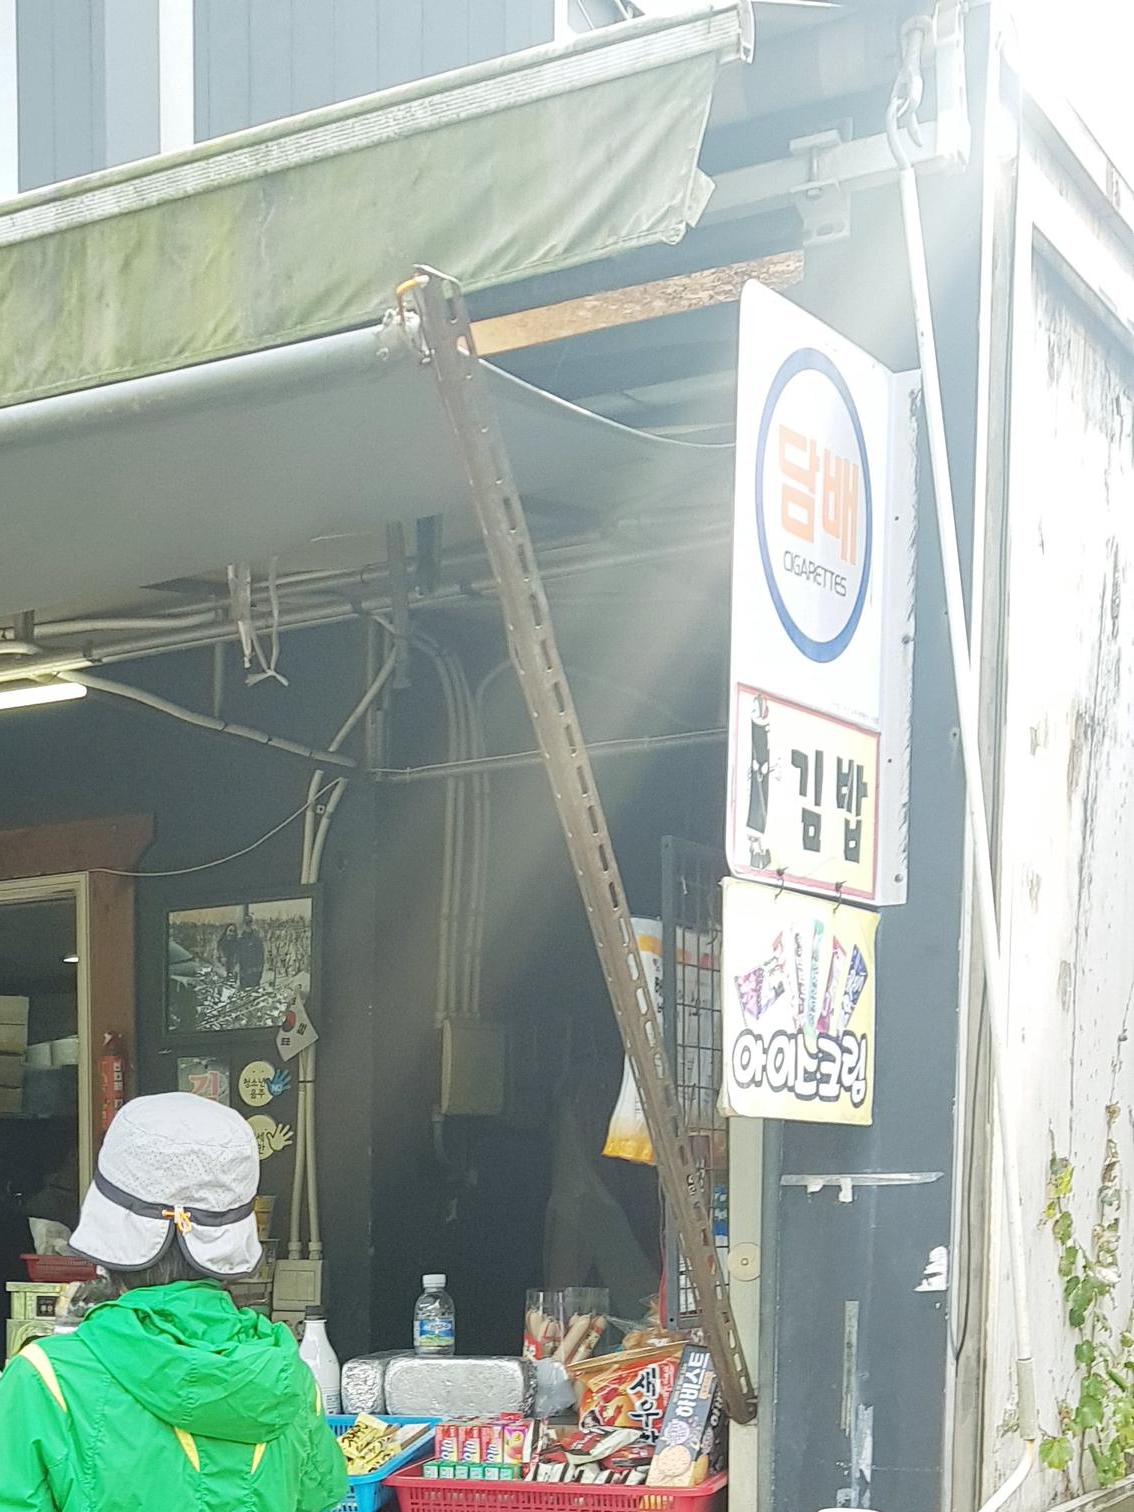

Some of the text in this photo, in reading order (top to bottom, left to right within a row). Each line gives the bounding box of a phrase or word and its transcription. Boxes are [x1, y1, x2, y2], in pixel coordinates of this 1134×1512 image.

[778, 424, 860, 567] 담배
[783, 550, 848, 598] CIGARETTES
[790, 747, 868, 865] 김밥
